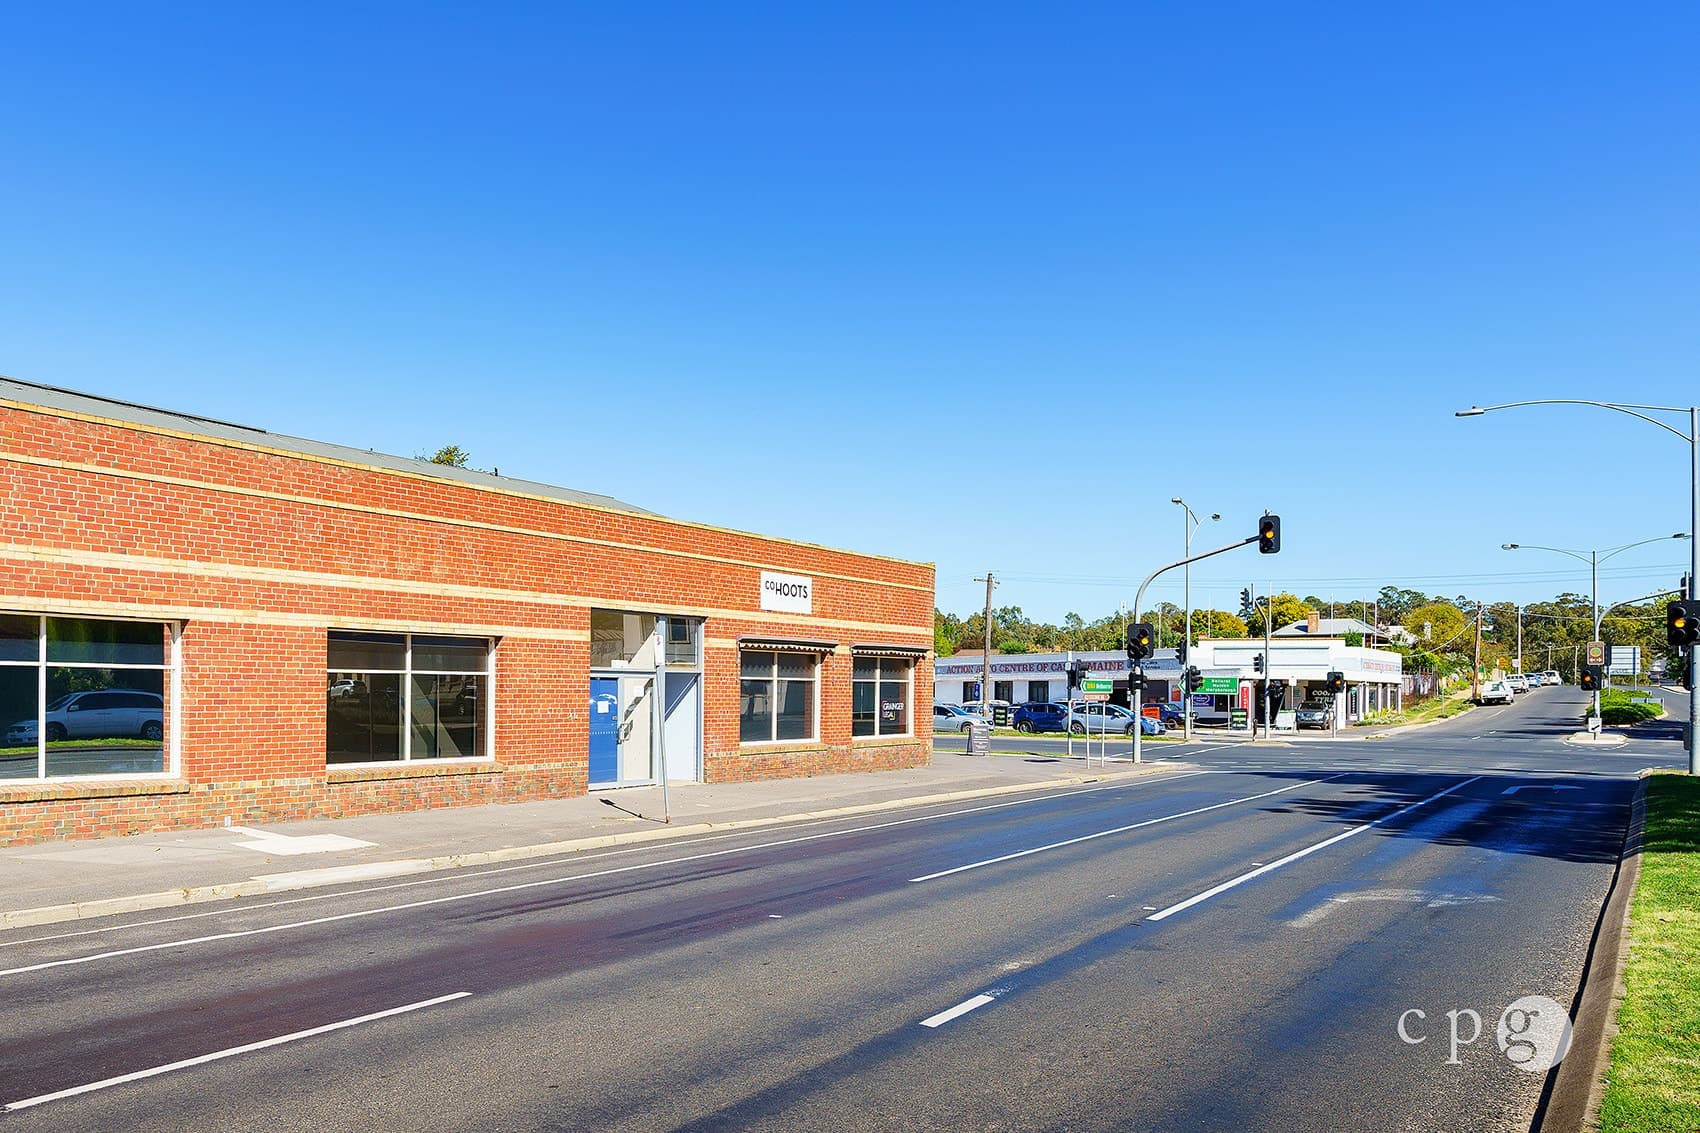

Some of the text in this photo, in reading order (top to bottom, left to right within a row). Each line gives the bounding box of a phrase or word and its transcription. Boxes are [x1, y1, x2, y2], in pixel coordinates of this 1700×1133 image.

[946, 661, 1125, 674] ACTION AUO CENTRE OF CAMAINE
